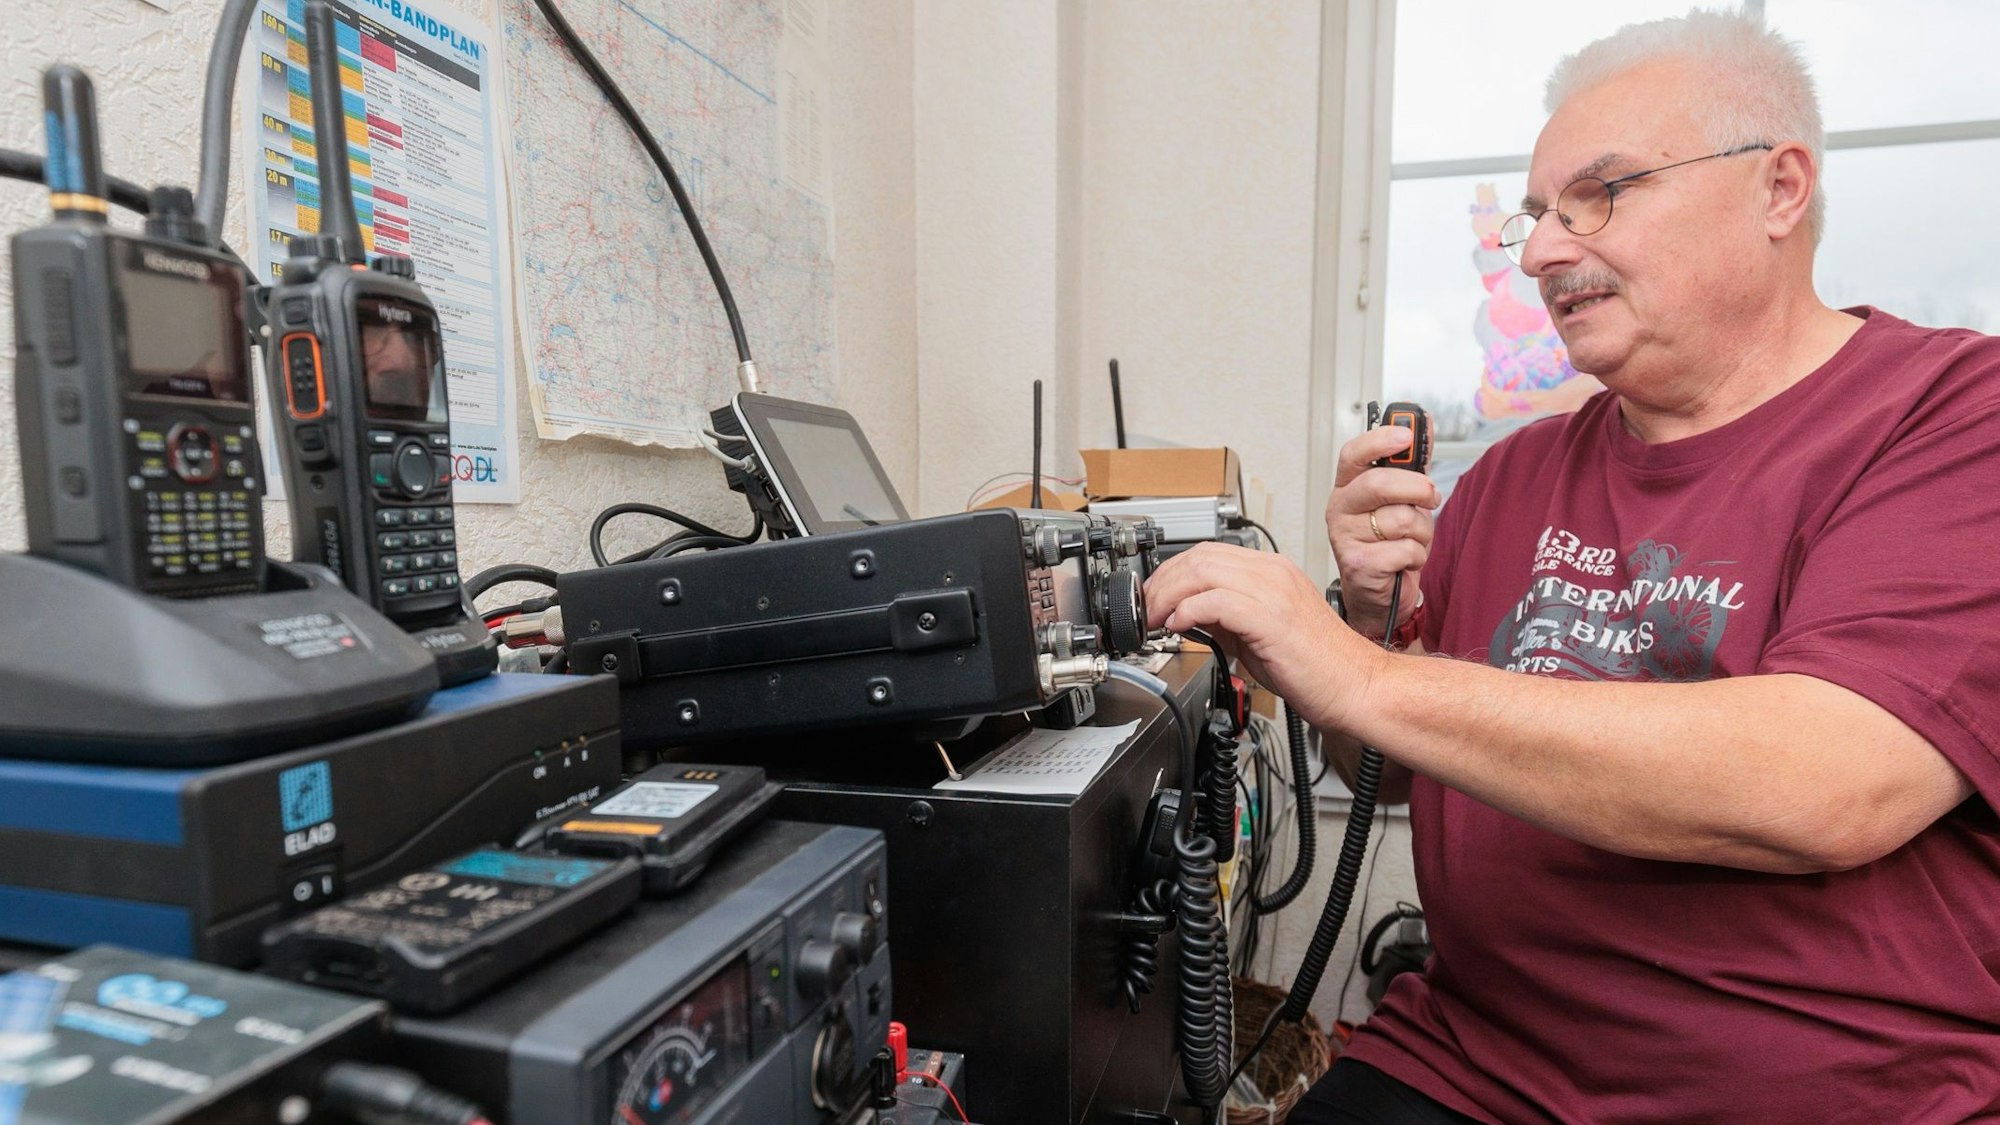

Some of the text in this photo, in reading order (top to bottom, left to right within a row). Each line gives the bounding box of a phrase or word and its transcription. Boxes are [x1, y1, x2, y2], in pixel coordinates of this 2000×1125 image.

[263, 12, 278, 30] 160
[262, 53, 273, 69] 80
[263, 116, 275, 129] 40
[267, 169, 279, 183] 20
[271, 230, 282, 243] 17
[272, 264, 283, 277] 15
[378, 304, 412, 323] Hytera
[1515, 574, 1745, 623] INTERNTIONAL
[1570, 619, 1654, 655] BIKS
[533, 765, 547, 780] ON
[284, 822, 336, 856] ELAD
